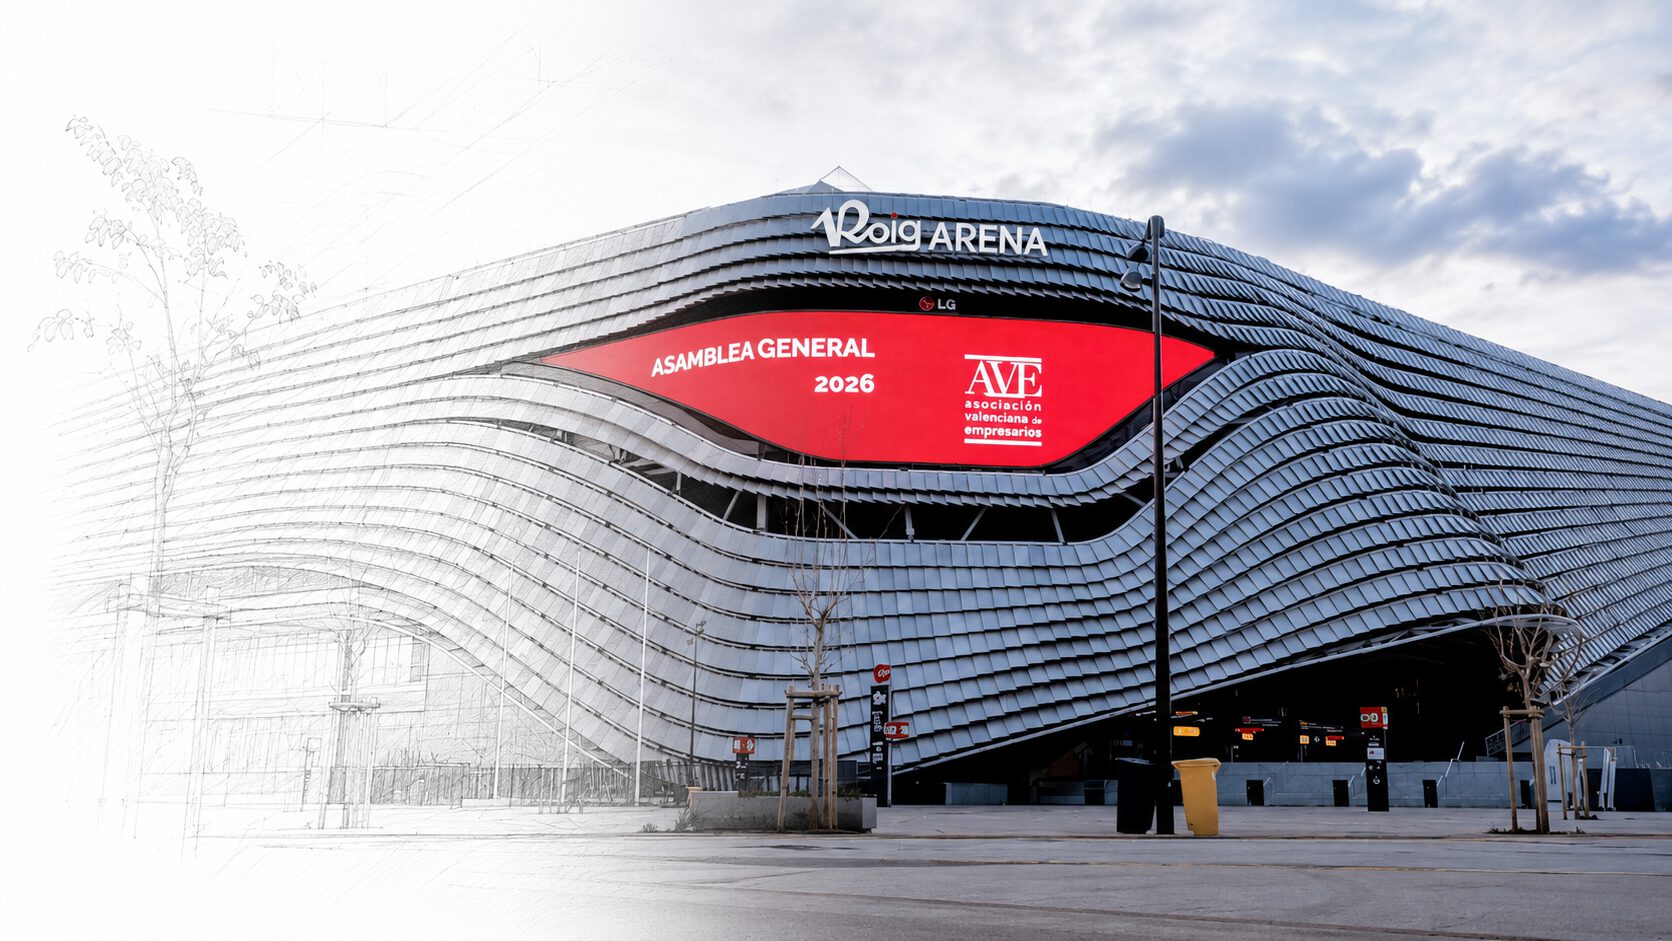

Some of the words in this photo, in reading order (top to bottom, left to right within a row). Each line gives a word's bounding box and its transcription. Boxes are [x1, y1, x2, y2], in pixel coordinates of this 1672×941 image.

[810, 199, 921, 255] Roig
[928, 222, 1048, 257] ARENA
[937, 299, 956, 311] LG
[651, 341, 755, 377] ASAMBLEA
[757, 338, 875, 358] GENERAL
[814, 373, 875, 393] 2026
[964, 360, 1042, 398] AVE
[964, 399, 1042, 411] asociación
[964, 411, 1029, 424] valenciana
[1031, 416, 1042, 425] de
[964, 425, 1042, 439] empresarios
